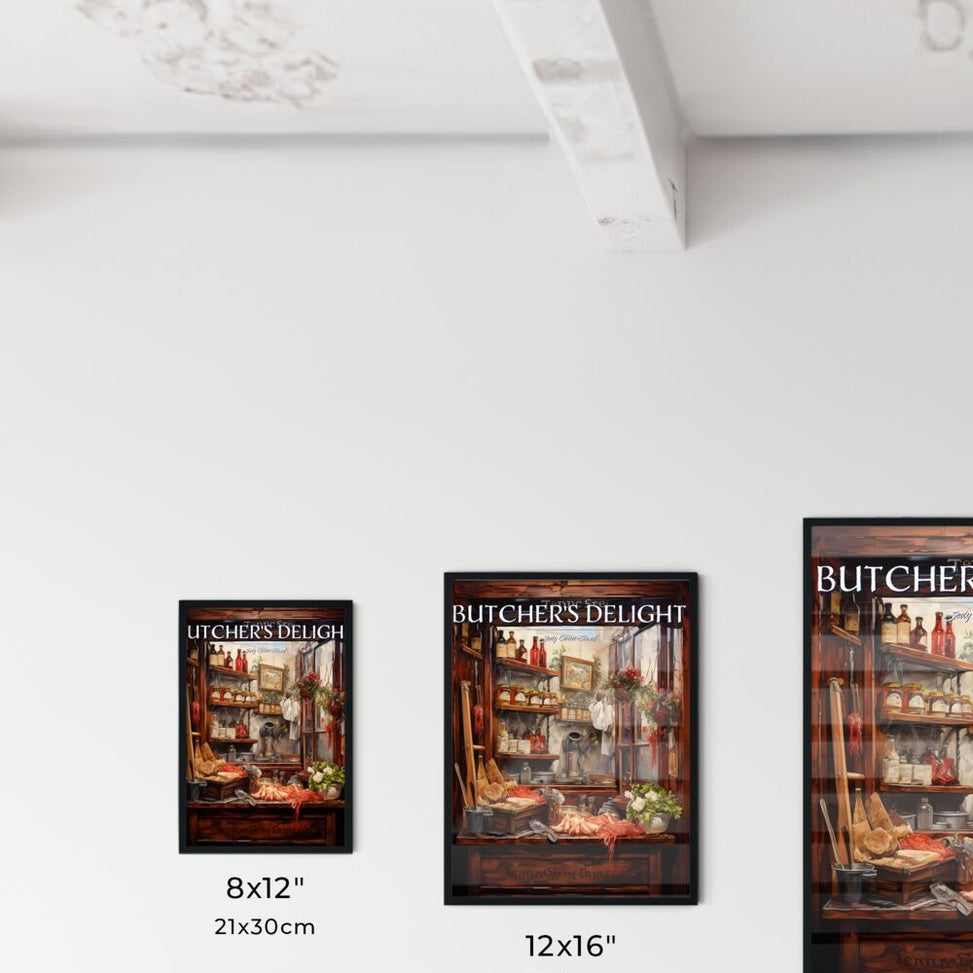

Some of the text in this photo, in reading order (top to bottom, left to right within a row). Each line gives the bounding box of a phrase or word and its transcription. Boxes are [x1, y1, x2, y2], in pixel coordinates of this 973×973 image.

[452, 604, 686, 623] BUTCHER'S DELIGHT
[187, 624, 273, 639] UTCHER'S
[278, 624, 344, 639] DELIGH
